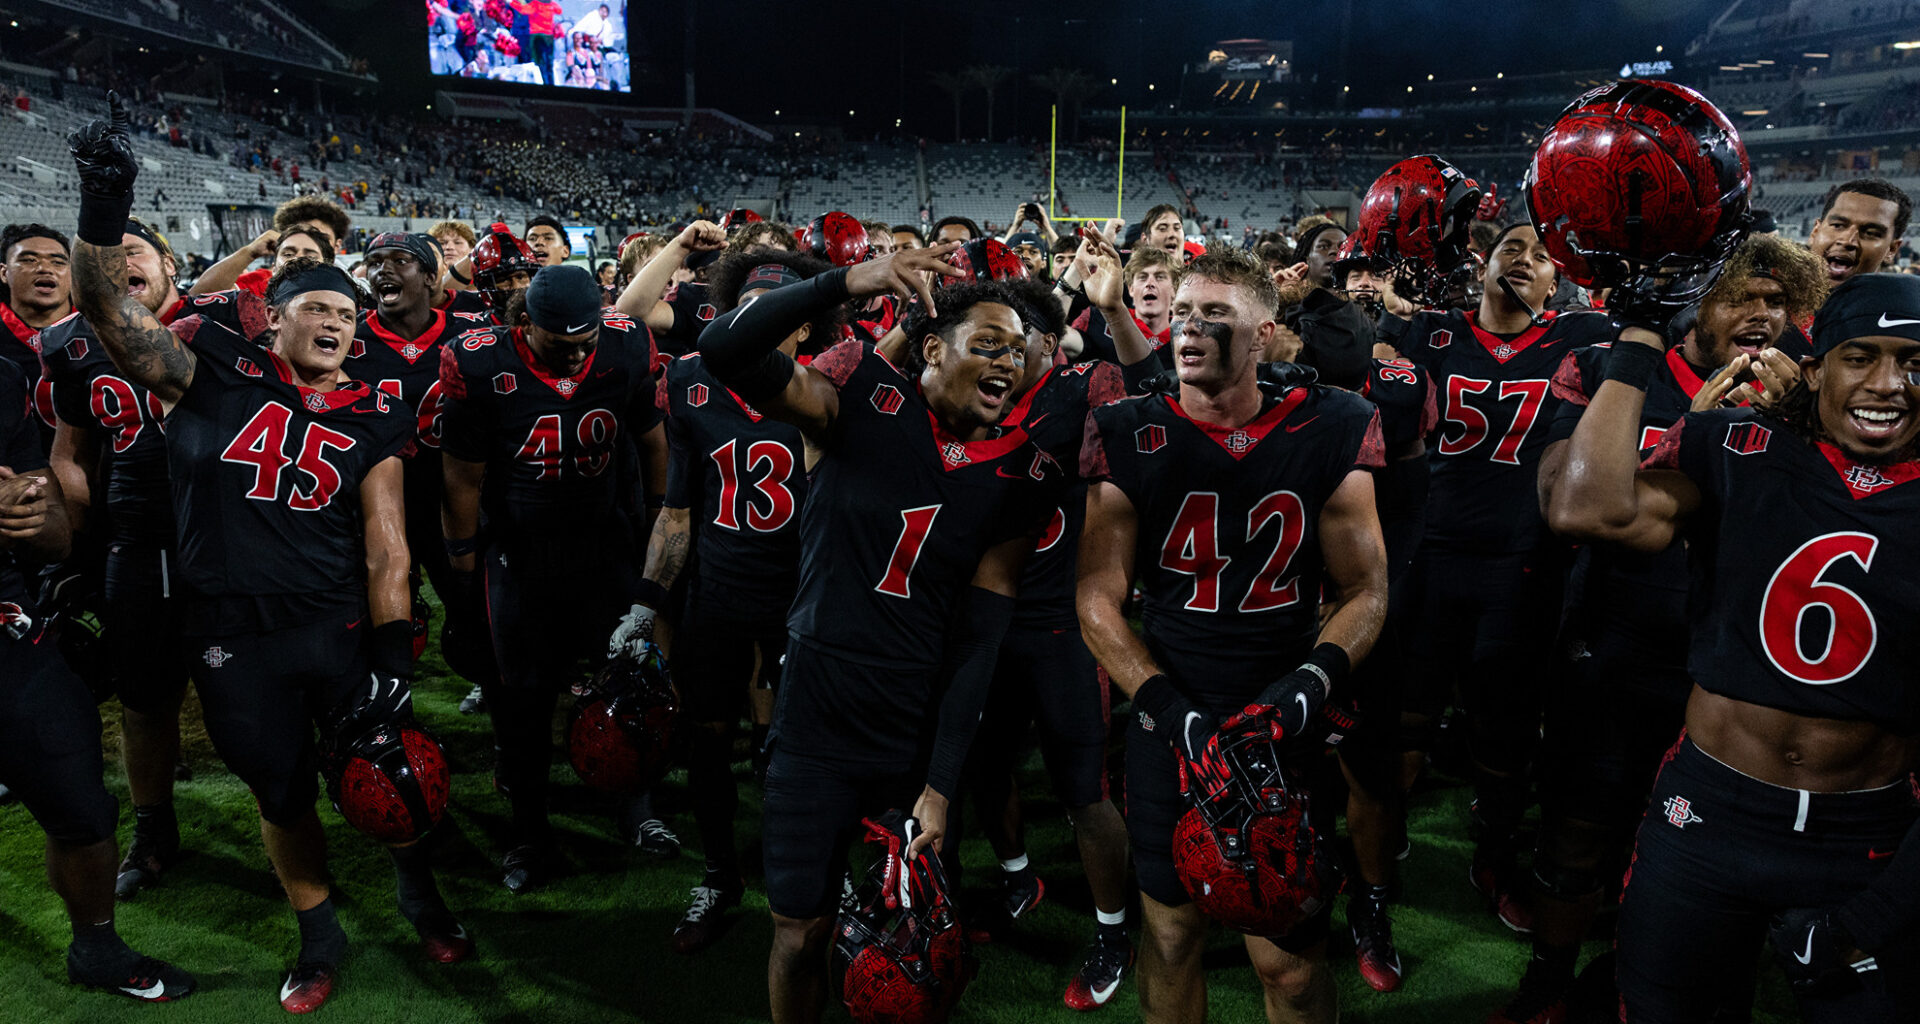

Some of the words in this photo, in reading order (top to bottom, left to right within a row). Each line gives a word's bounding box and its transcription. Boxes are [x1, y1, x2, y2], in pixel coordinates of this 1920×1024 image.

[90, 374, 168, 453] 9
[375, 390, 390, 413] C
[1379, 357, 1418, 385] 36
[220, 400, 357, 511] 45
[514, 408, 618, 481] 48
[1029, 451, 1051, 481] C
[1438, 374, 1550, 466] 57
[709, 437, 795, 533] 13
[874, 503, 944, 599] 1
[1159, 489, 1306, 613] 42
[1759, 530, 1880, 685] 6
